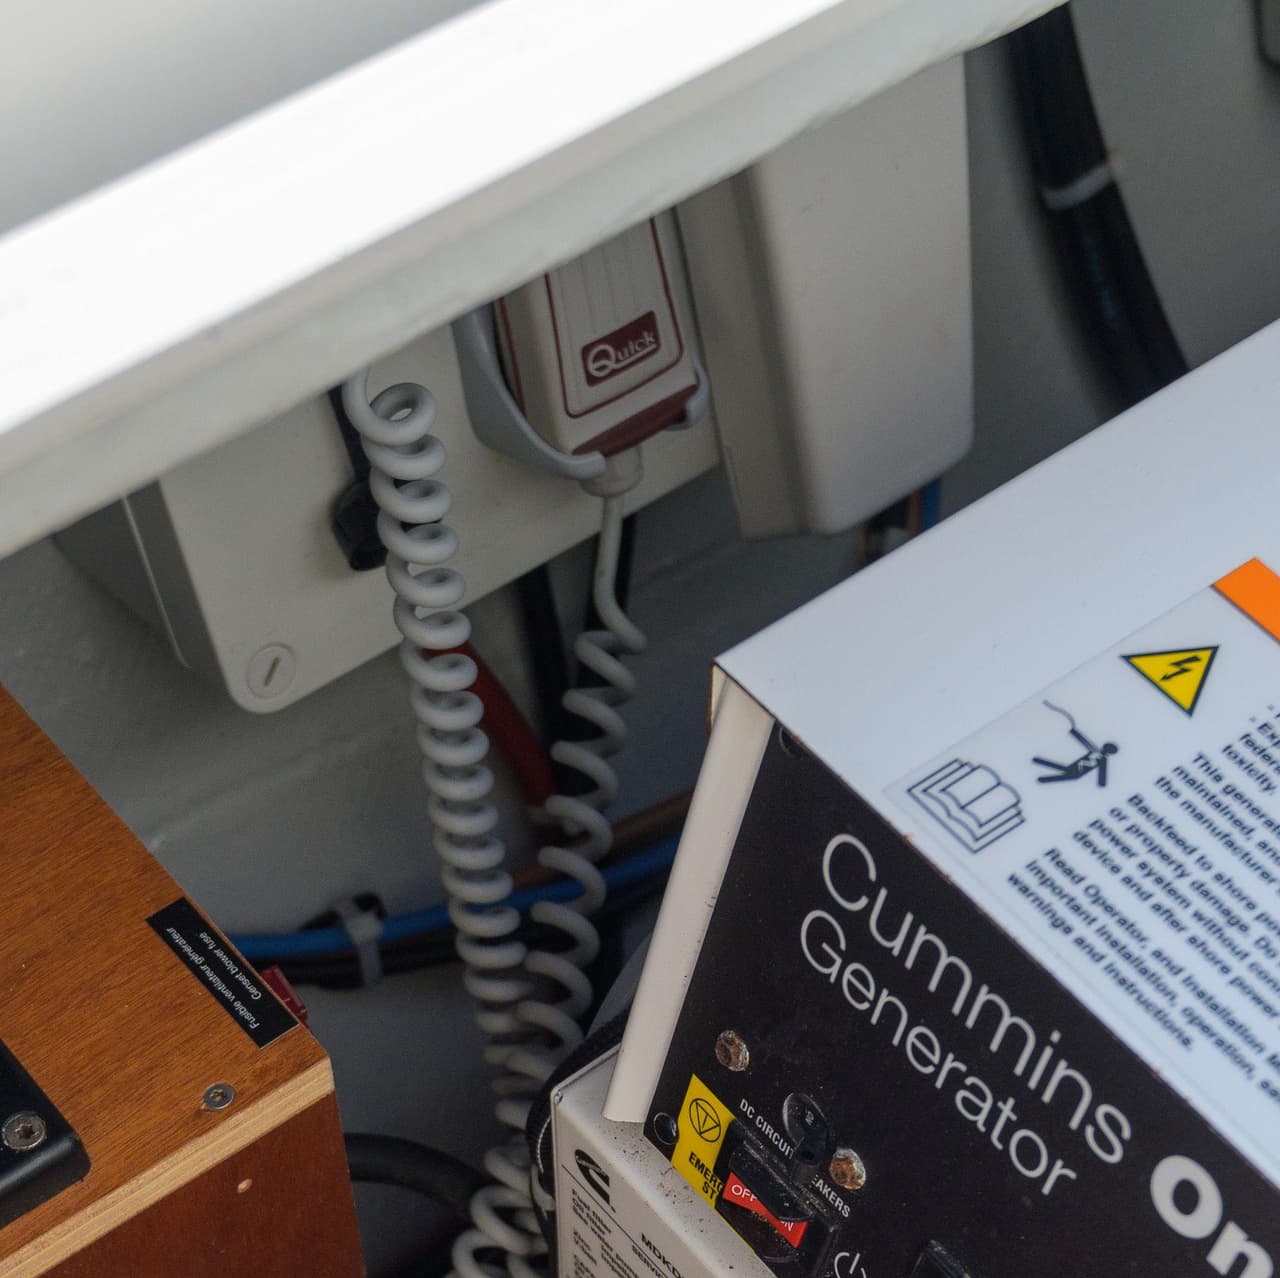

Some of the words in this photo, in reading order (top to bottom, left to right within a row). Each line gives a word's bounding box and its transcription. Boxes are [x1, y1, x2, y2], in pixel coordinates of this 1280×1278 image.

[587, 332, 658, 378] Quick
[1153, 774, 1182, 800] the
[1191, 751, 1224, 785] This
[1024, 858, 1099, 927] important
[1086, 817, 1139, 859] power
[1135, 859, 1193, 910] system
[1190, 908, 1251, 962] without
[1107, 806, 1130, 823] or
[1122, 822, 1191, 880] property
[1252, 934, 1280, 960] Do
[1126, 792, 1199, 856] Backfeed
[1193, 853, 1214, 872] to
[1211, 871, 1258, 912] shore
[198, 930, 217, 950] fuse
[1006, 872, 1075, 936] warnings
[1071, 934, 1108, 964] and
[1071, 829, 1123, 875] device
[1119, 873, 1155, 902] and
[1148, 901, 1188, 934] after
[1184, 933, 1232, 976] shore
[212, 947, 239, 975] blower
[233, 970, 262, 1000] Genset
[1042, 846, 1087, 886] Read
[1148, 948, 1185, 977] and
[1178, 973, 1267, 1055] Installation
[232, 999, 261, 1029] Fusible
[820, 832, 1132, 1164] Cummins
[799, 908, 1077, 1196] Generator
[739, 1097, 756, 1119] DC
[810, 1173, 851, 1218] AKERS
